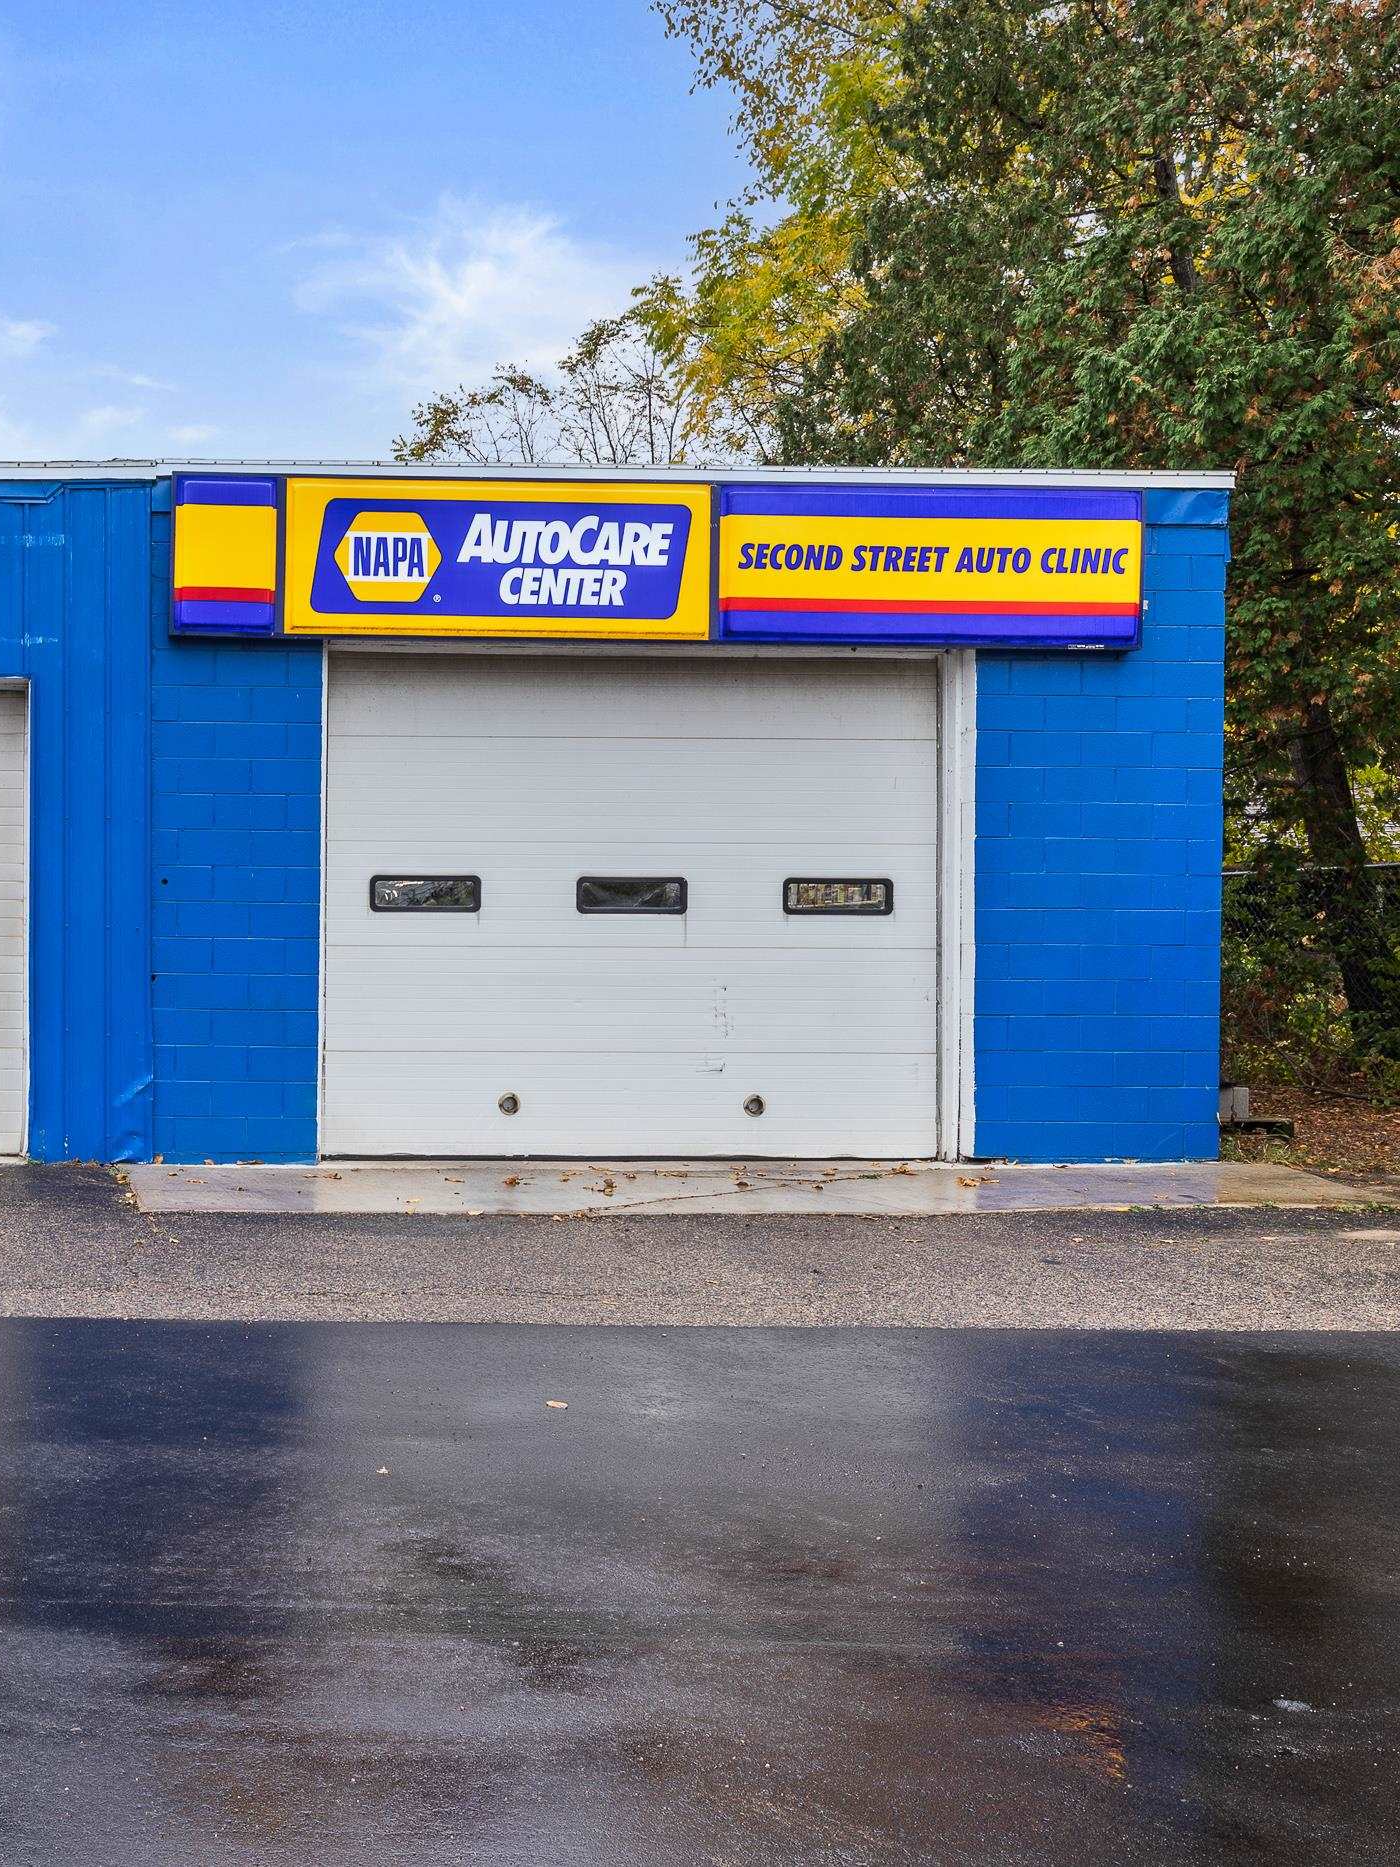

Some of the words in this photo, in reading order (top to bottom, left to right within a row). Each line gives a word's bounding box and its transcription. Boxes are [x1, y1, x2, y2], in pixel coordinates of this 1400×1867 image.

[353, 536, 426, 577] NAPA
[457, 513, 674, 566] AUTOCARE
[737, 542, 844, 571] SECOND
[850, 543, 950, 573] STREET
[954, 546, 1032, 574] AUTO
[1040, 547, 1129, 575] CLINIC
[499, 567, 627, 606] CENTER
